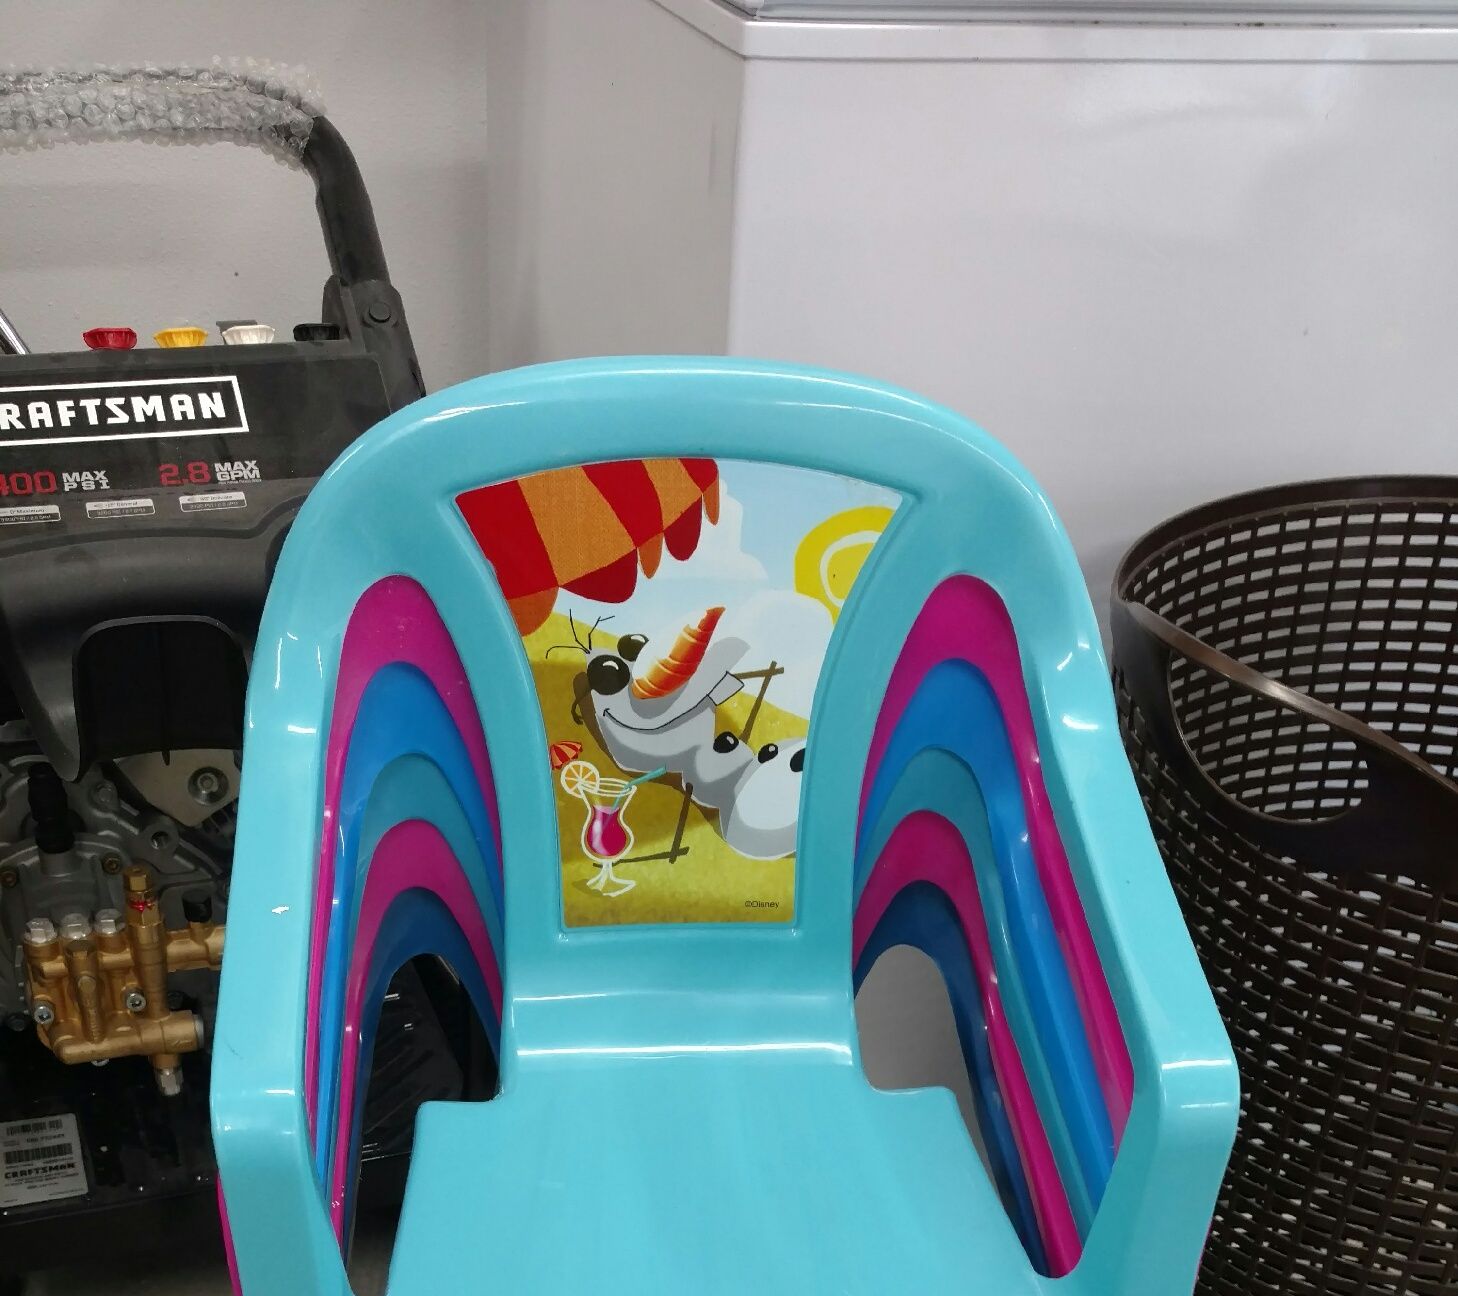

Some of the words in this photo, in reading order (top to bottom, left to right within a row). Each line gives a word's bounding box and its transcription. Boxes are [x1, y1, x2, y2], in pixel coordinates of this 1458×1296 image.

[214, 460, 259, 472] MAX
[62, 470, 108, 482] MAX
[158, 462, 212, 486] 2.8
[216, 470, 261, 481] GPM
[64, 480, 110, 492] PSI
[4, 1163, 76, 1178] CRAFTSMAN
